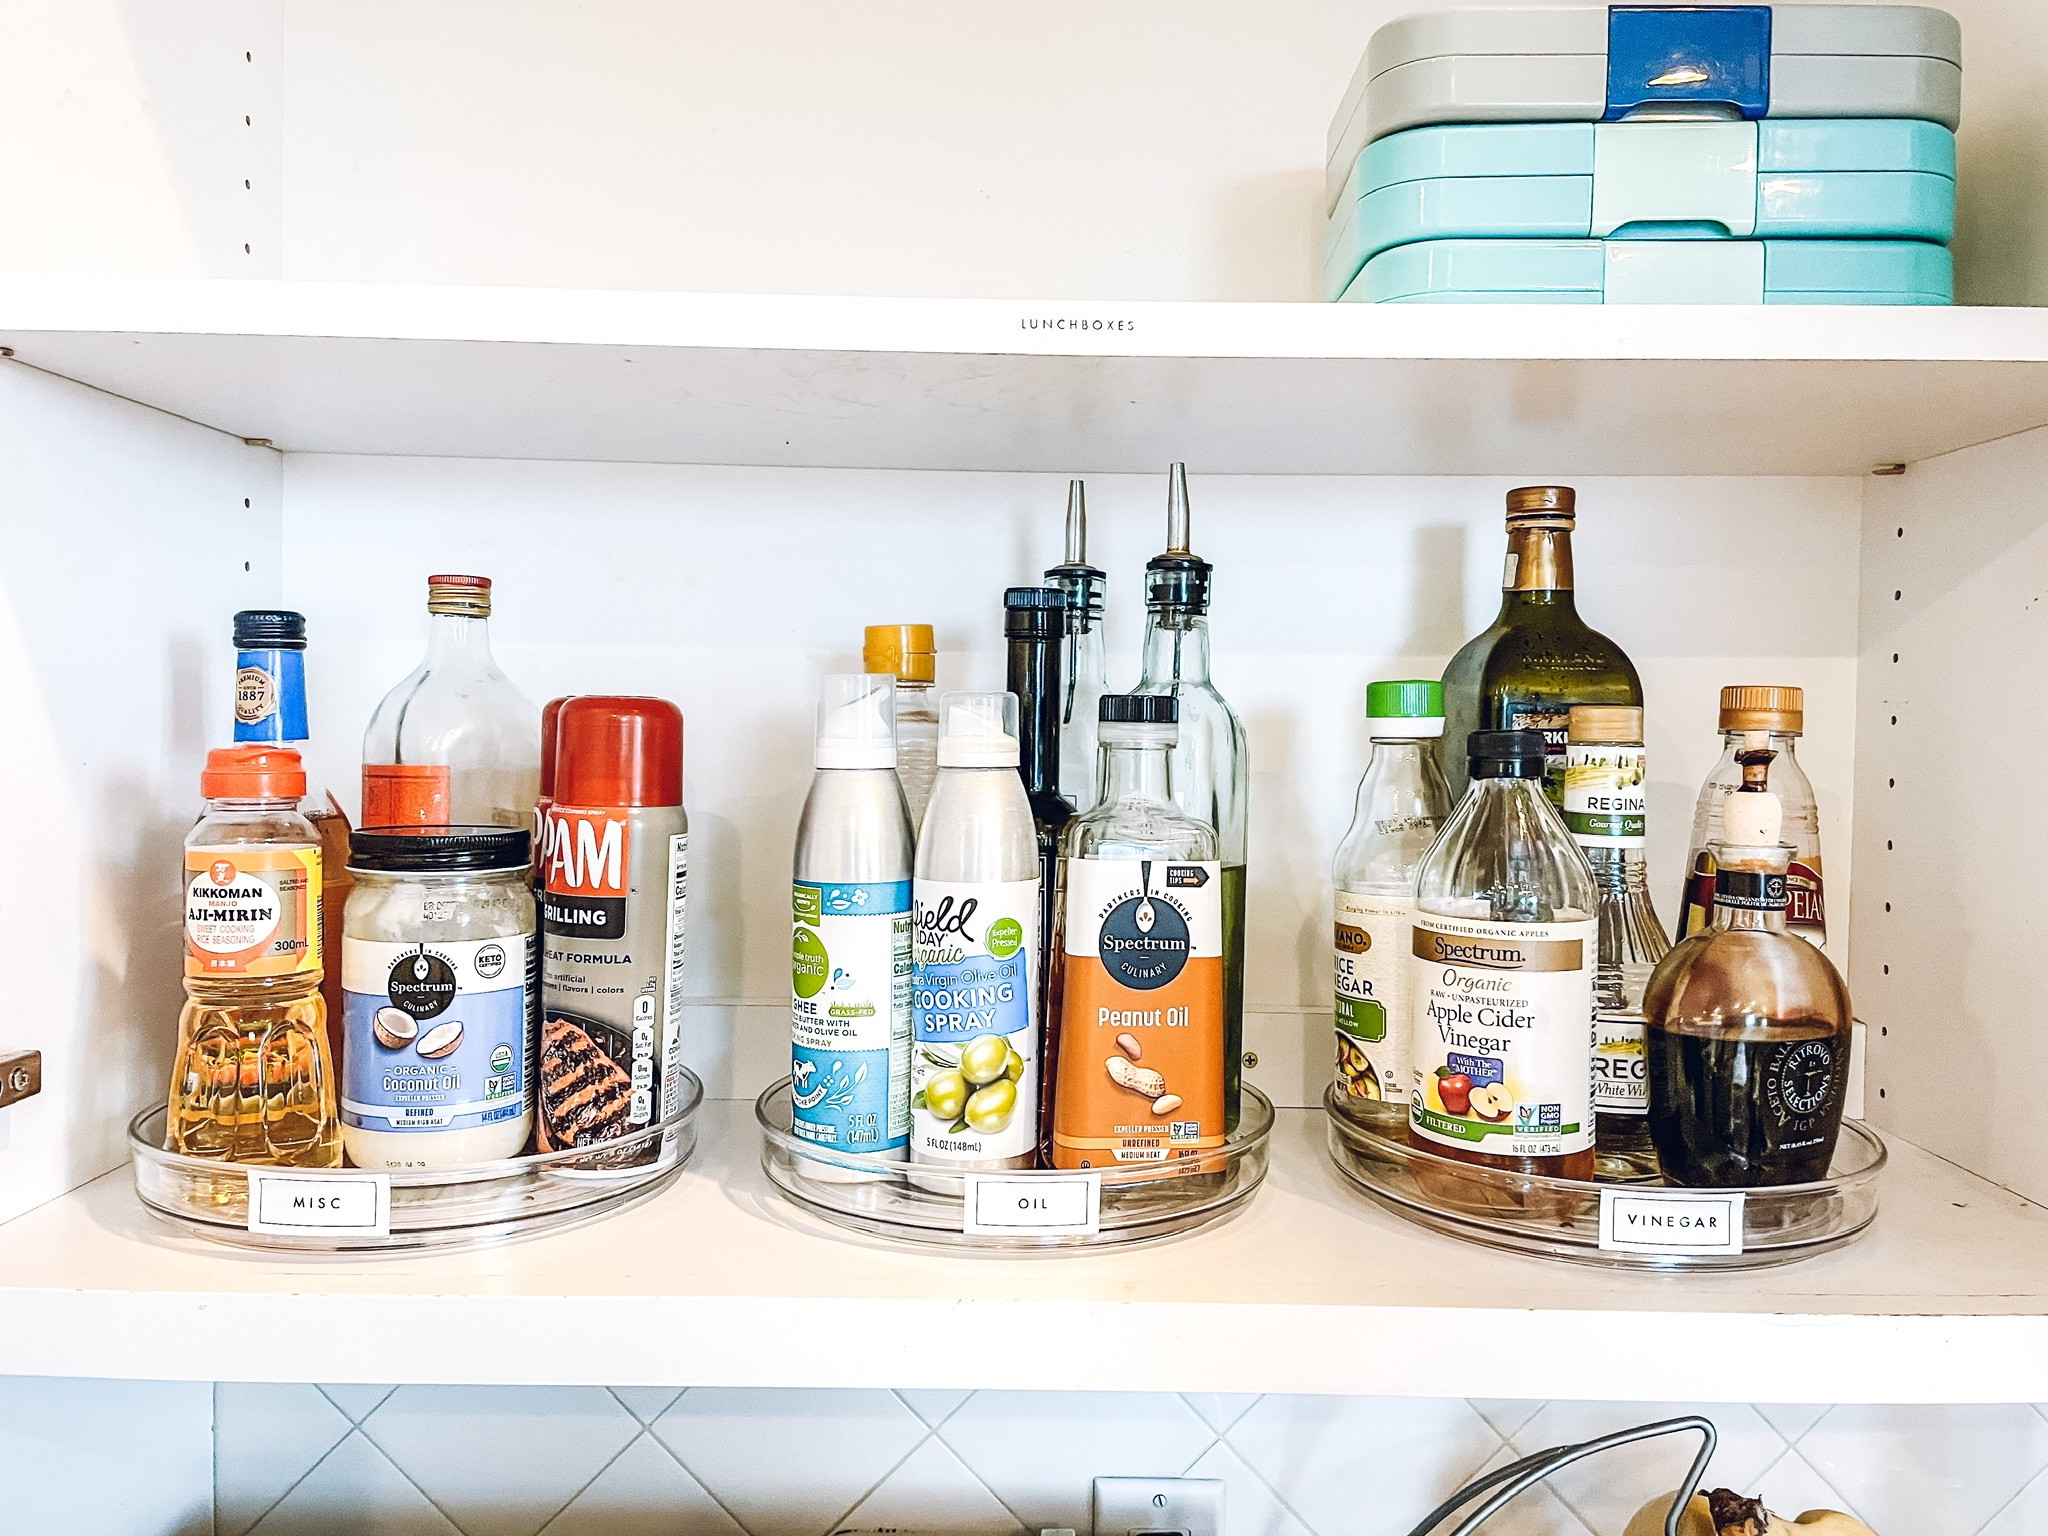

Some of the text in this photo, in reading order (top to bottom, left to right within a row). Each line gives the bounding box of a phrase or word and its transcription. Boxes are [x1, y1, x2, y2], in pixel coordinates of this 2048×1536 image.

[1021, 318, 1135, 331] LUNCHBOXES
[239, 690, 265, 701] 1887
[1587, 796, 1645, 811] REGINA
[1169, 869, 1194, 877] COOKING
[192, 886, 263, 899] KIKKOMAN
[1098, 888, 1193, 922] PARTNERS IN COOKING
[188, 907, 273, 922] AJI-MIRIN
[196, 924, 255, 933] SWEET COOKING
[992, 927, 1018, 938] Expeller
[1420, 919, 1435, 928] FROM
[1435, 922, 1474, 933] CERTIFIED
[1476, 927, 1517, 937] ORGANIC
[196, 934, 256, 944] RICE SEASONING
[274, 937, 309, 951] 300mL
[919, 931, 945, 948] DAY
[991, 937, 1018, 948] Pressed
[1103, 934, 1186, 953] Spectrum
[478, 955, 503, 964] KETO
[566, 953, 632, 964] FORMULA
[804, 954, 824, 963] truth
[925, 962, 1017, 989] Virgin Olive Oil
[1121, 962, 1168, 978] CULINARY
[554, 973, 586, 984] artificial
[1334, 972, 1373, 996] EGAR
[1442, 968, 1513, 993] Organic
[390, 981, 454, 994] Spectrum
[562, 984, 589, 993] flavors
[596, 986, 624, 994] colors
[914, 983, 1013, 1010] COOKING
[1430, 988, 1529, 1008] RAW UNPASTEURIZED
[403, 1000, 440, 1012] CULINARY
[793, 998, 817, 1015] GHEE
[830, 1008, 874, 1016] GRASS-FED
[1098, 1006, 1189, 1027] Peanut Oil
[1426, 999, 1536, 1028] Apple Cider
[799, 1015, 824, 1026] BUTTER
[826, 1019, 850, 1027] WITH
[925, 1009, 997, 1033] SPRAY
[799, 1025, 813, 1034] AND
[814, 1027, 840, 1037] OLIVE
[842, 1029, 858, 1037] OIL
[805, 1036, 832, 1047] SPRAY
[1438, 1024, 1512, 1055] Vinegar
[1456, 1056, 1492, 1068] With The
[1788, 1044, 1831, 1071] RITROVO
[393, 1065, 449, 1076] ORGANIC
[383, 1073, 461, 1092] Coconut Oil
[808, 1088, 823, 1104] POINT
[1783, 1073, 1832, 1111] SELECTIONS
[405, 1108, 434, 1117] REFINED
[848, 1114, 878, 1128] 5 FL OZ
[1426, 1115, 1467, 1134] FILTERED
[1793, 1117, 1815, 1131] IGP
[846, 1128, 880, 1145] (147mL)
[1122, 1139, 1160, 1148] UNREFINED
[926, 1137, 982, 1153] 5 FL OZ (148mL)
[1512, 1144, 1519, 1153] 16
[1519, 1144, 1527, 1154] FL
[1527, 1144, 1537, 1154] OZ
[1121, 1151, 1160, 1159] MEDIUM HEAT
[293, 1196, 341, 1209] MISC
[1018, 1197, 1048, 1210] OIL
[1627, 1213, 1718, 1228] VINEGAR
